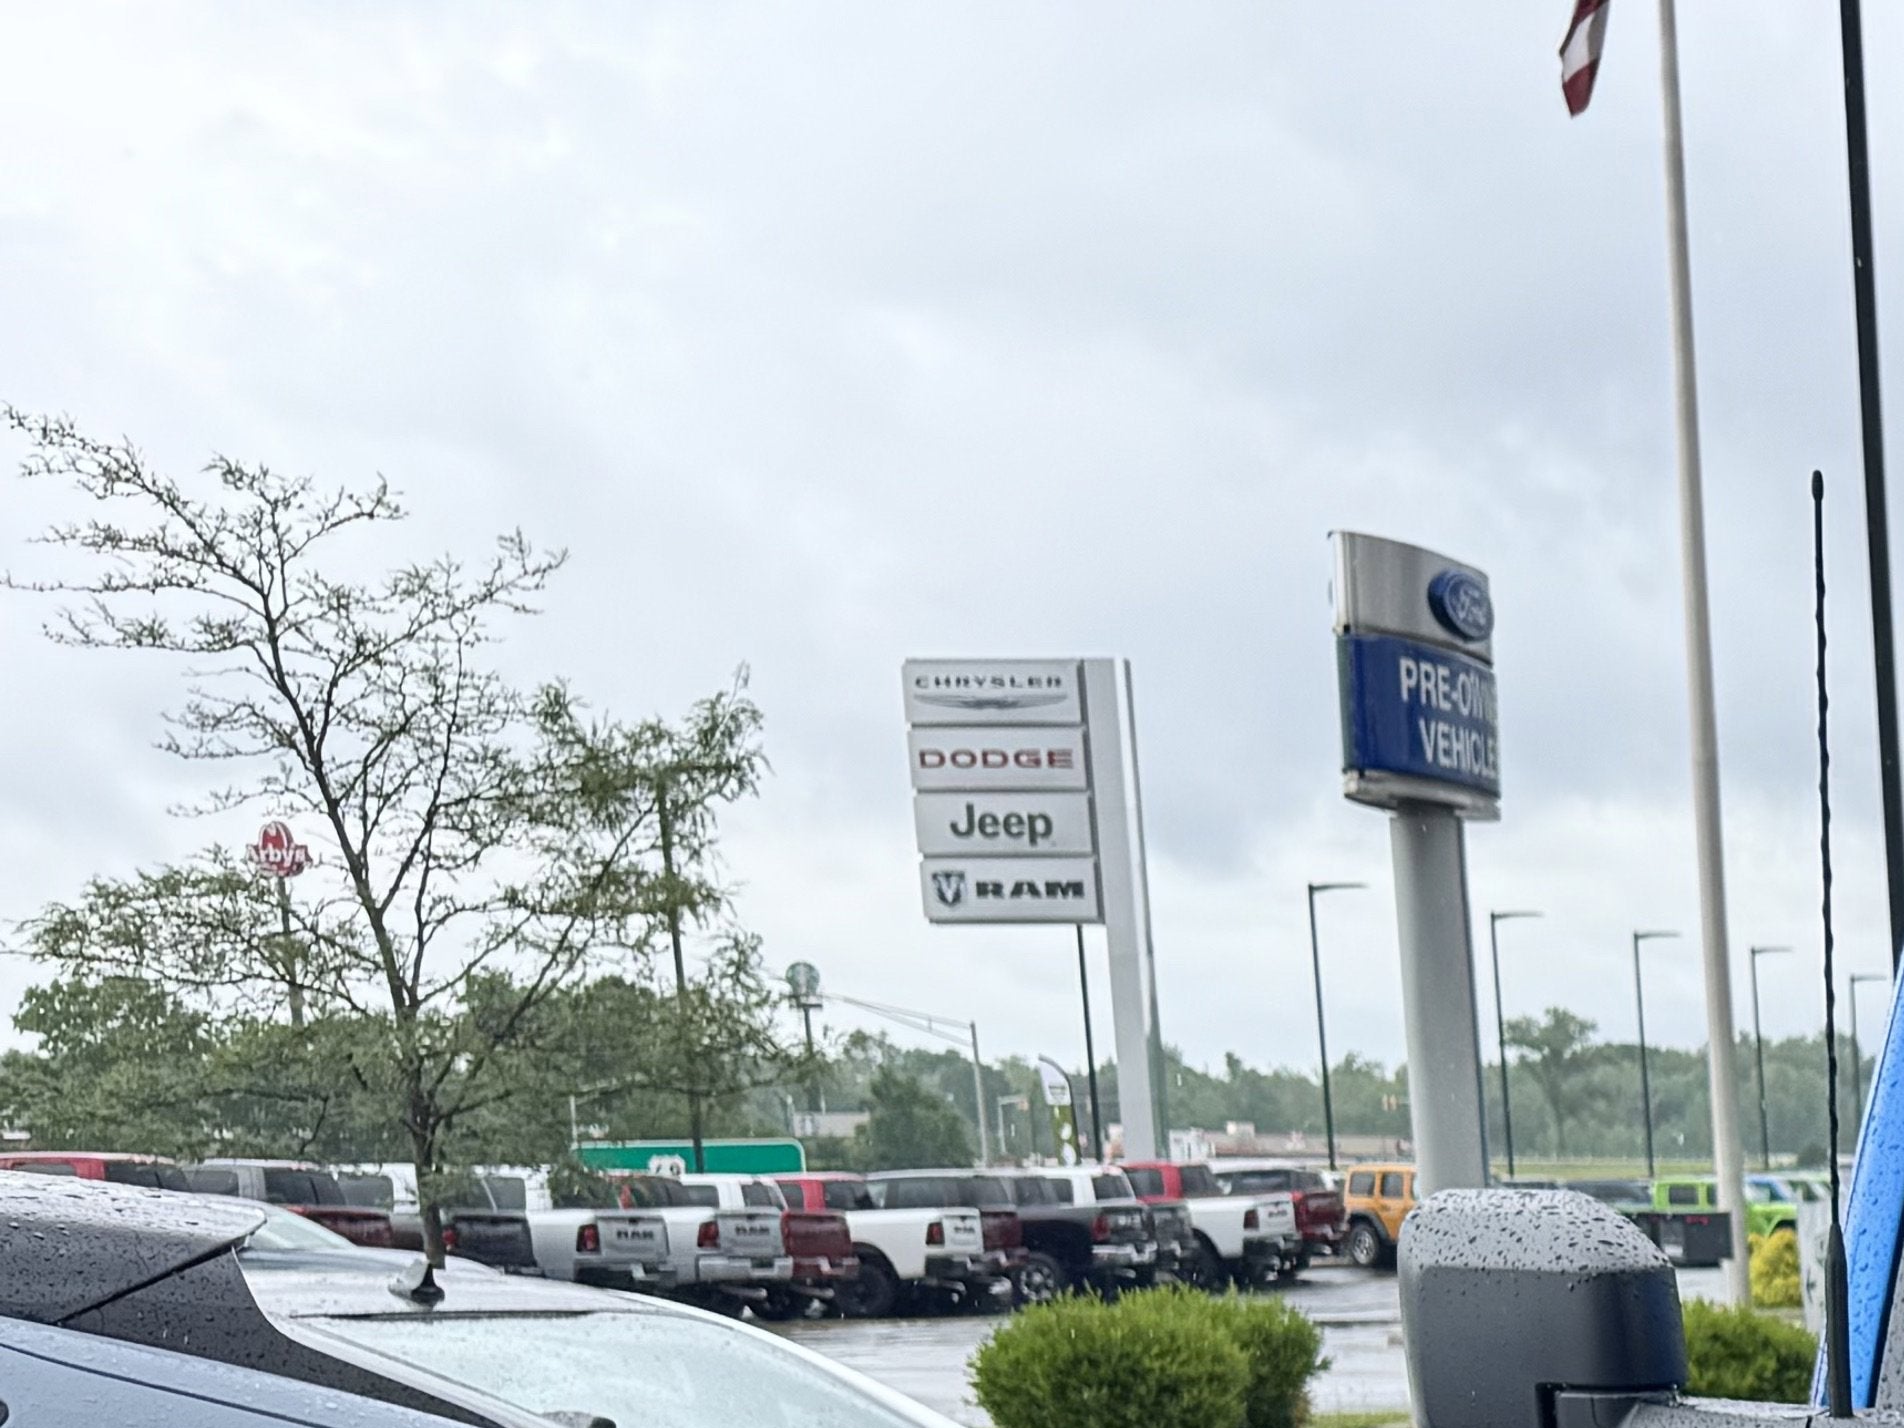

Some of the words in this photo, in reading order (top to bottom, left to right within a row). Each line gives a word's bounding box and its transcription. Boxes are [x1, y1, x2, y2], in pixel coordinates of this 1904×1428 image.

[915, 675, 1063, 689] CHRYSLER
[919, 749, 1074, 769] DODGE
[950, 801, 1053, 847] Jeep
[975, 880, 1085, 899] RAM
